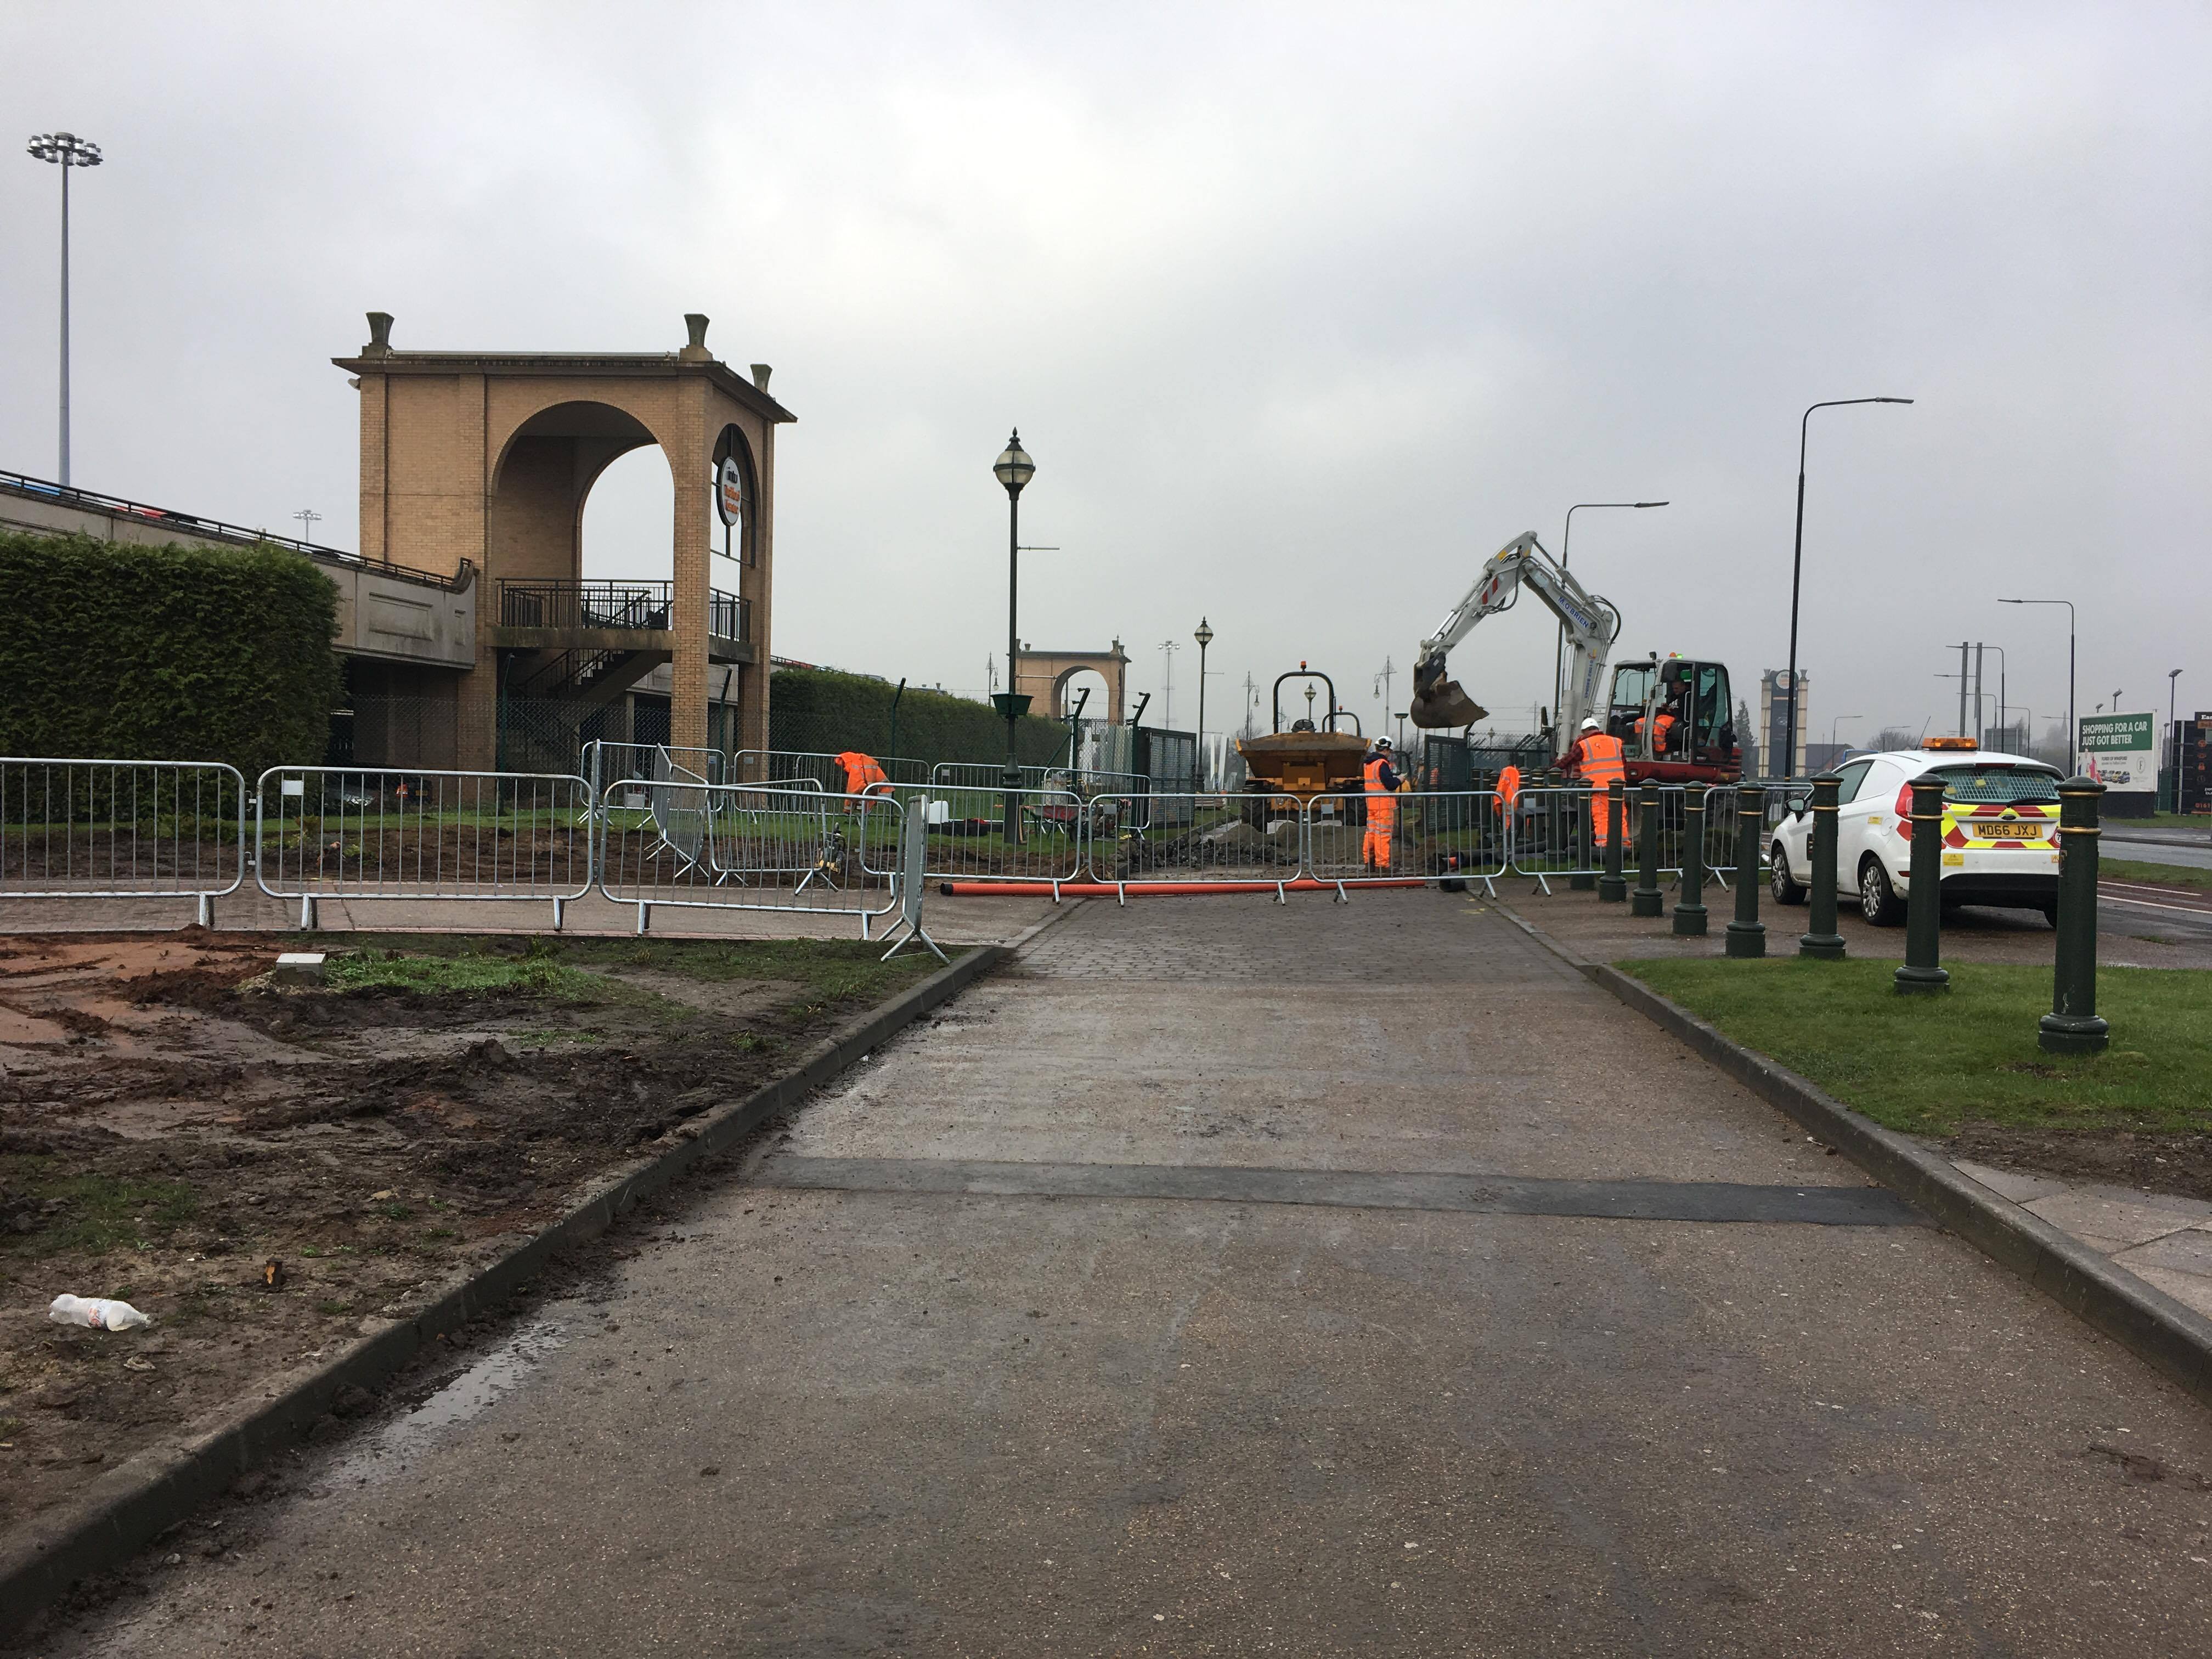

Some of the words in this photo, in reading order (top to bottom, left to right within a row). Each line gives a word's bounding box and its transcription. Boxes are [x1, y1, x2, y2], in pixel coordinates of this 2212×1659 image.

[727, 466, 738, 484] intu
[2082, 724, 2114, 735] SHOPPING
[2115, 723, 2127, 732] FOR
[2129, 722, 2133, 732] A
[2134, 721, 2147, 732] CAR
[2082, 736, 2096, 746] JUST
[2096, 735, 2109, 745] GOT
[2111, 734, 2132, 744] BETTER
[1978, 825, 2011, 836] MD66
[2014, 825, 2037, 836] JXJ
